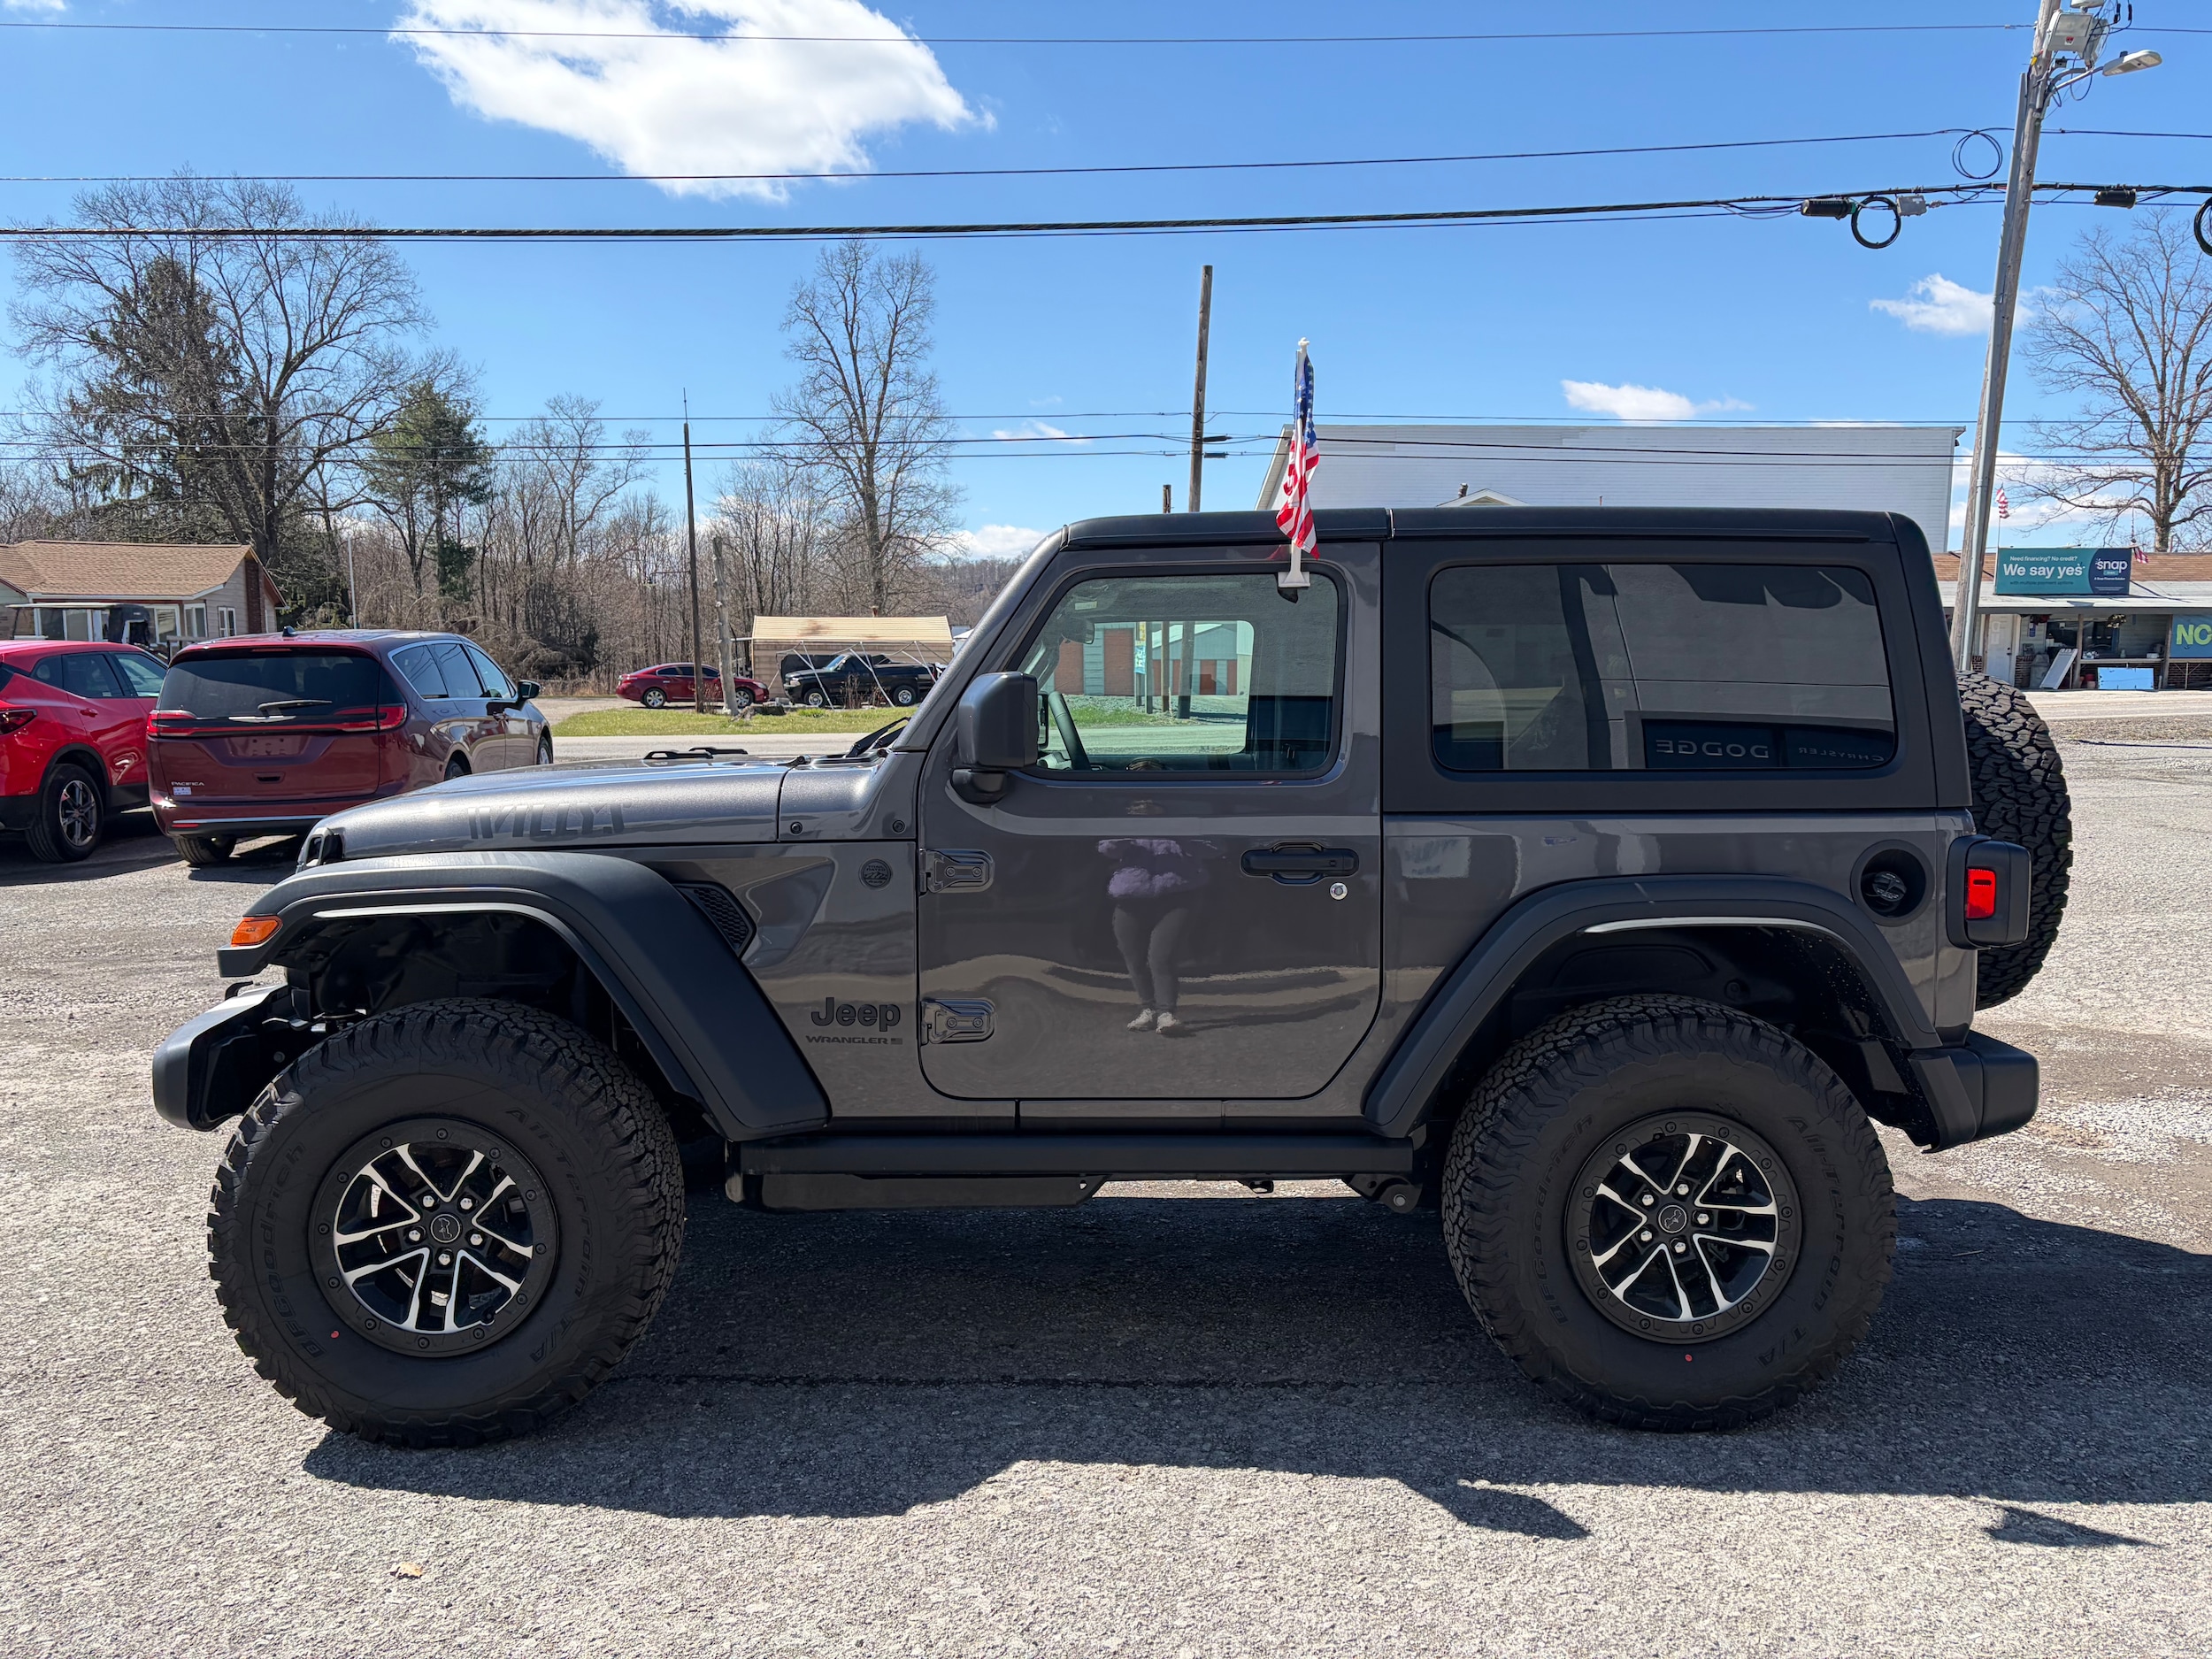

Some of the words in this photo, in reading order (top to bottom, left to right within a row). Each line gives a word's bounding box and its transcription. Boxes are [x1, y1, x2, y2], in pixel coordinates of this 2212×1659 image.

[2003, 563, 2026, 576] We
[2029, 565, 2055, 580] say
[2056, 565, 2084, 580] yes
[2096, 558, 2128, 573] snap
[810, 997, 901, 1033] Jeep
[805, 1035, 888, 1045] WRANGLER
[1532, 1114, 1594, 1326] BFGoodrich
[261, 1141, 327, 1359] BFGoodrich
